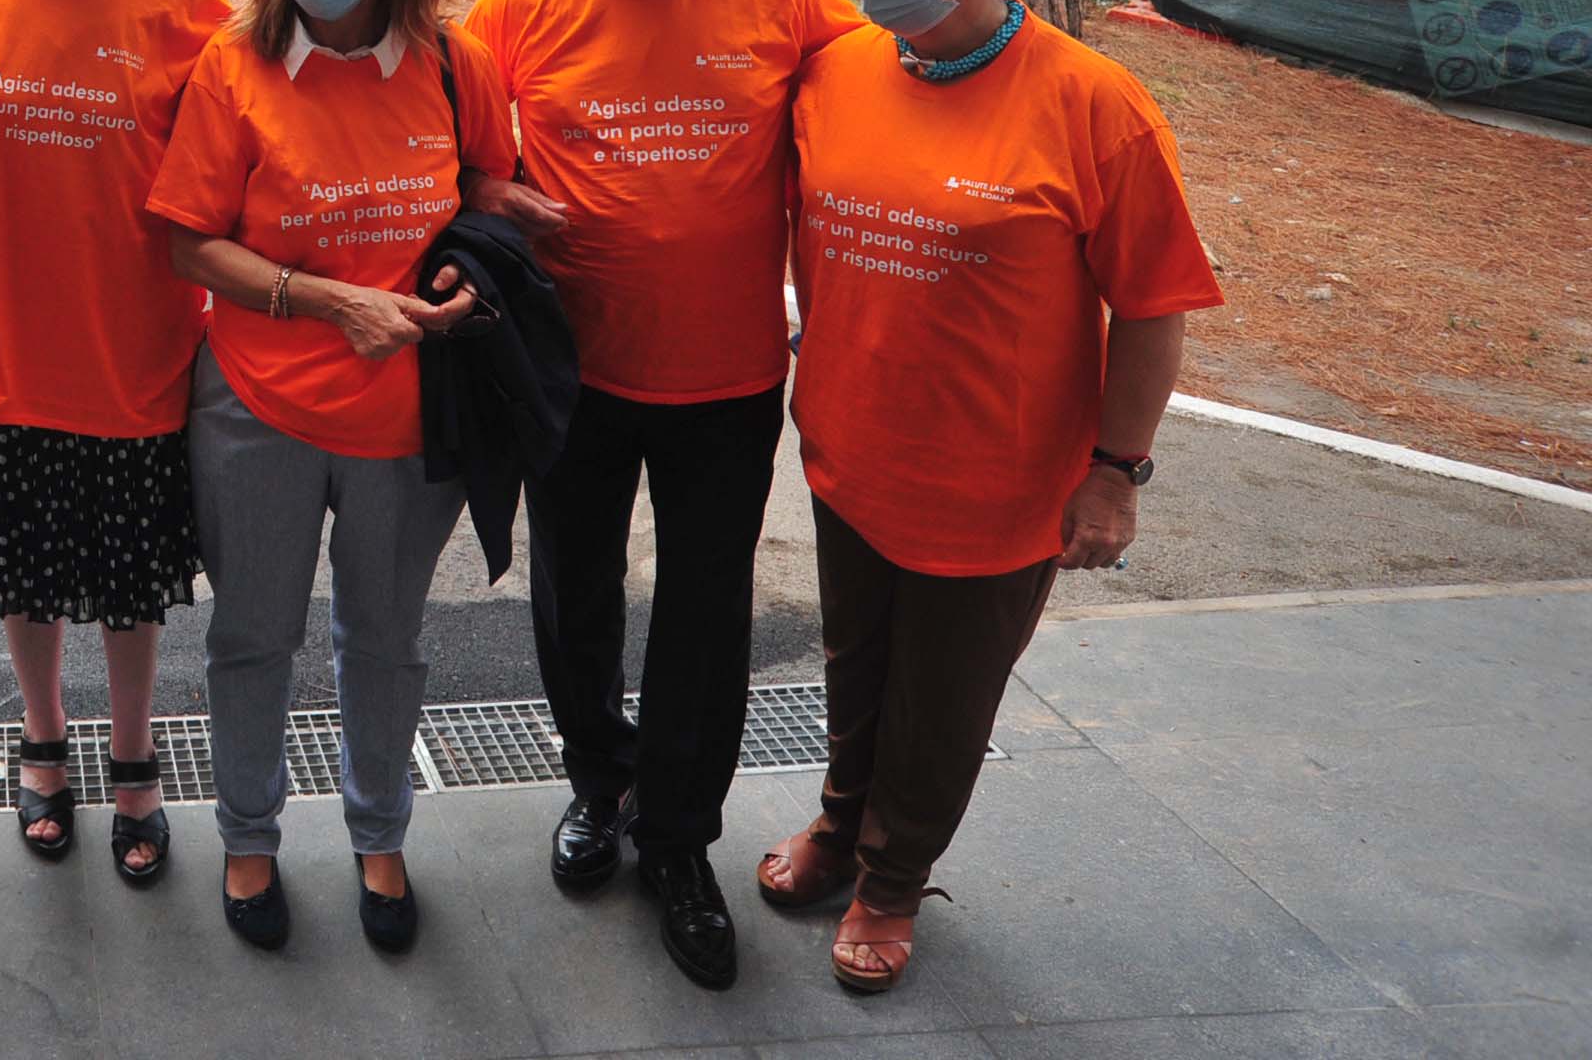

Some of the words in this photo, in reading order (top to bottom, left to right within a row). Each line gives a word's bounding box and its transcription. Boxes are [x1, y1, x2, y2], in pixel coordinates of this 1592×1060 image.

[51, 81, 117, 103] adesso
[25, 105, 75, 122] parto
[81, 109, 136, 131] sicuro
[579, 96, 646, 119] "Agisci
[654, 95, 725, 112] adesso
[5, 124, 102, 149] rispettoso"
[562, 127, 589, 143] per
[596, 125, 622, 139] un
[630, 121, 684, 141] parto
[691, 119, 749, 136] sicuro
[594, 150, 605, 162] e
[612, 144, 718, 166] rispettoso"
[302, 177, 369, 202] "Agisci
[375, 174, 434, 194] adesso
[280, 213, 313, 230] per
[320, 209, 346, 224] un
[353, 201, 403, 223] parto
[410, 197, 453, 215] sicuro
[816, 190, 881, 219] "Agisci
[887, 207, 959, 236] adesso
[317, 235, 328, 248] e
[336, 222, 431, 247] rispettoso"
[830, 222, 854, 239] un
[861, 230, 914, 252] parto
[921, 240, 989, 264] sicuro
[824, 247, 836, 259] e
[842, 248, 949, 283] rispettoso"
